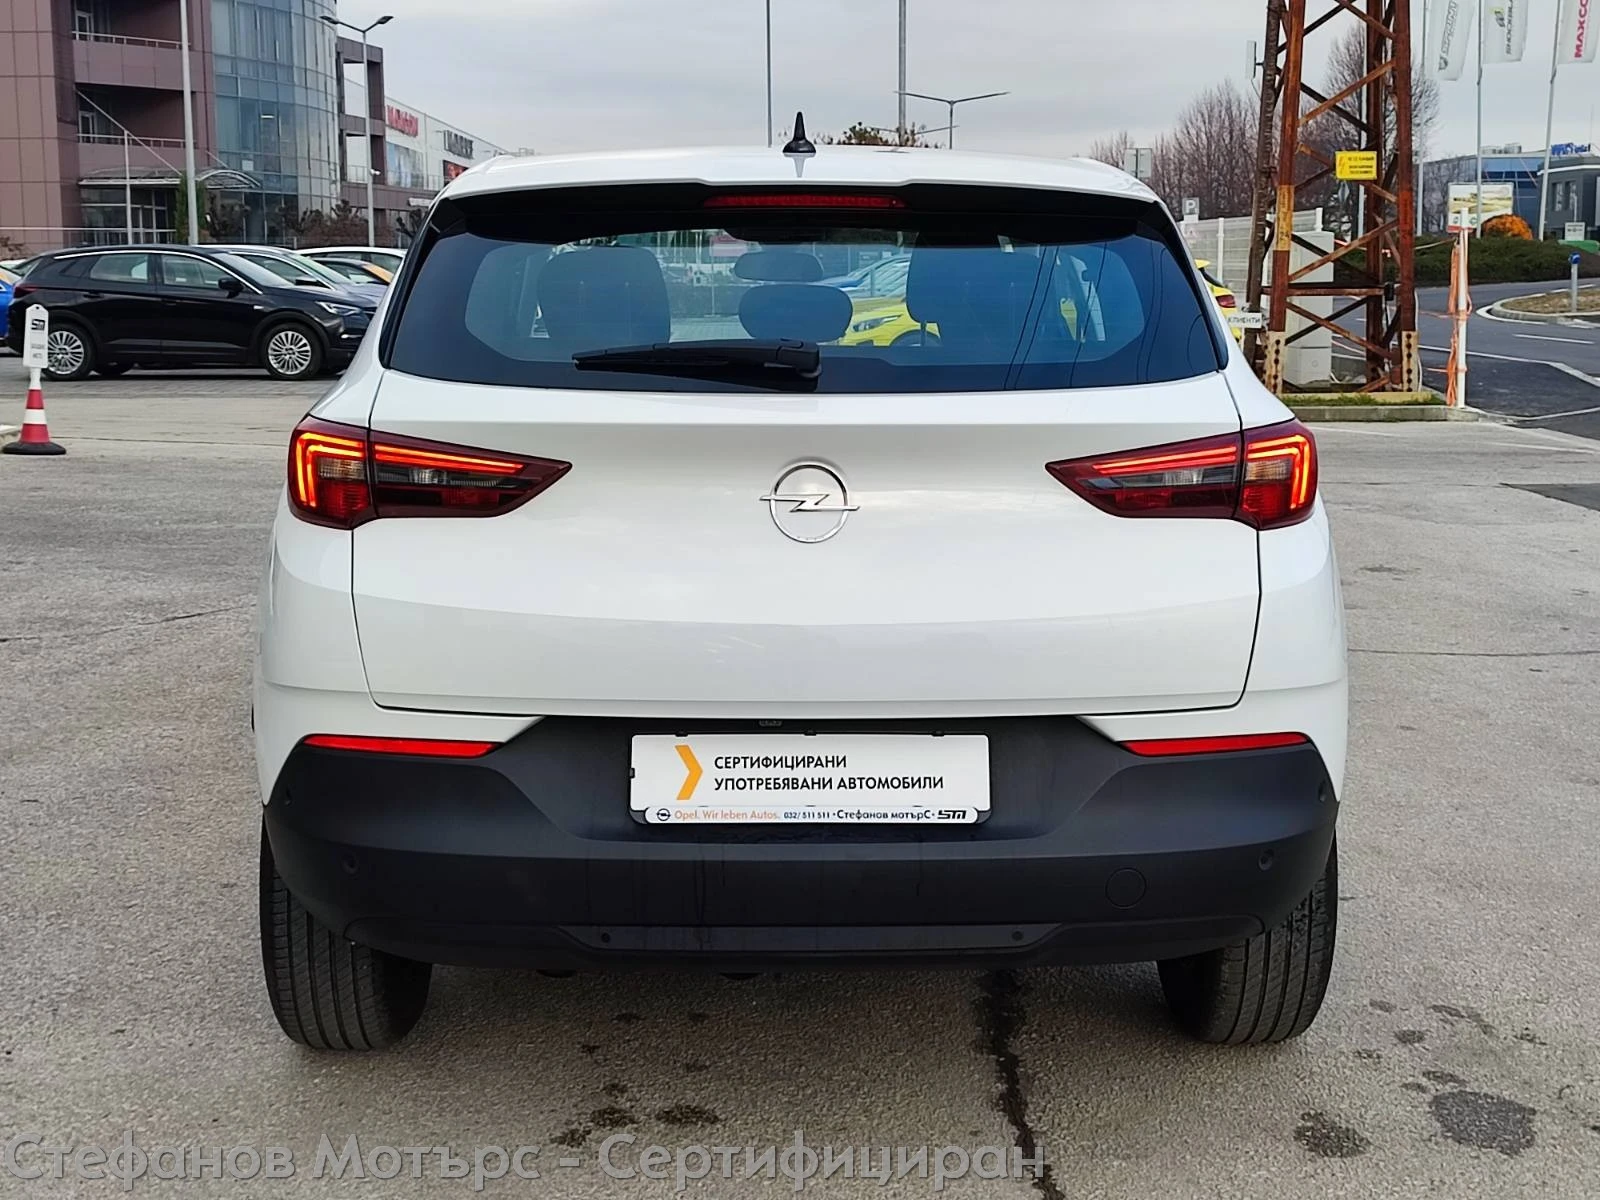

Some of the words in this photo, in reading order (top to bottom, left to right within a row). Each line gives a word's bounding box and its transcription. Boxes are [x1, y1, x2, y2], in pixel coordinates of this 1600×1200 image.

[1186, 200, 1196, 213] P
[714, 755, 847, 770] СЕРТИФИЦИРАНИ
[714, 777, 833, 791] УПОТРЕБЯВАНИ
[837, 776, 944, 790] АВТОМОБИЛИ
[703, 810, 720, 820] Wir
[721, 810, 749, 820] leben
[803, 811, 815, 820] 511
[817, 811, 830, 820] 511
[837, 809, 889, 821] Стефанов
